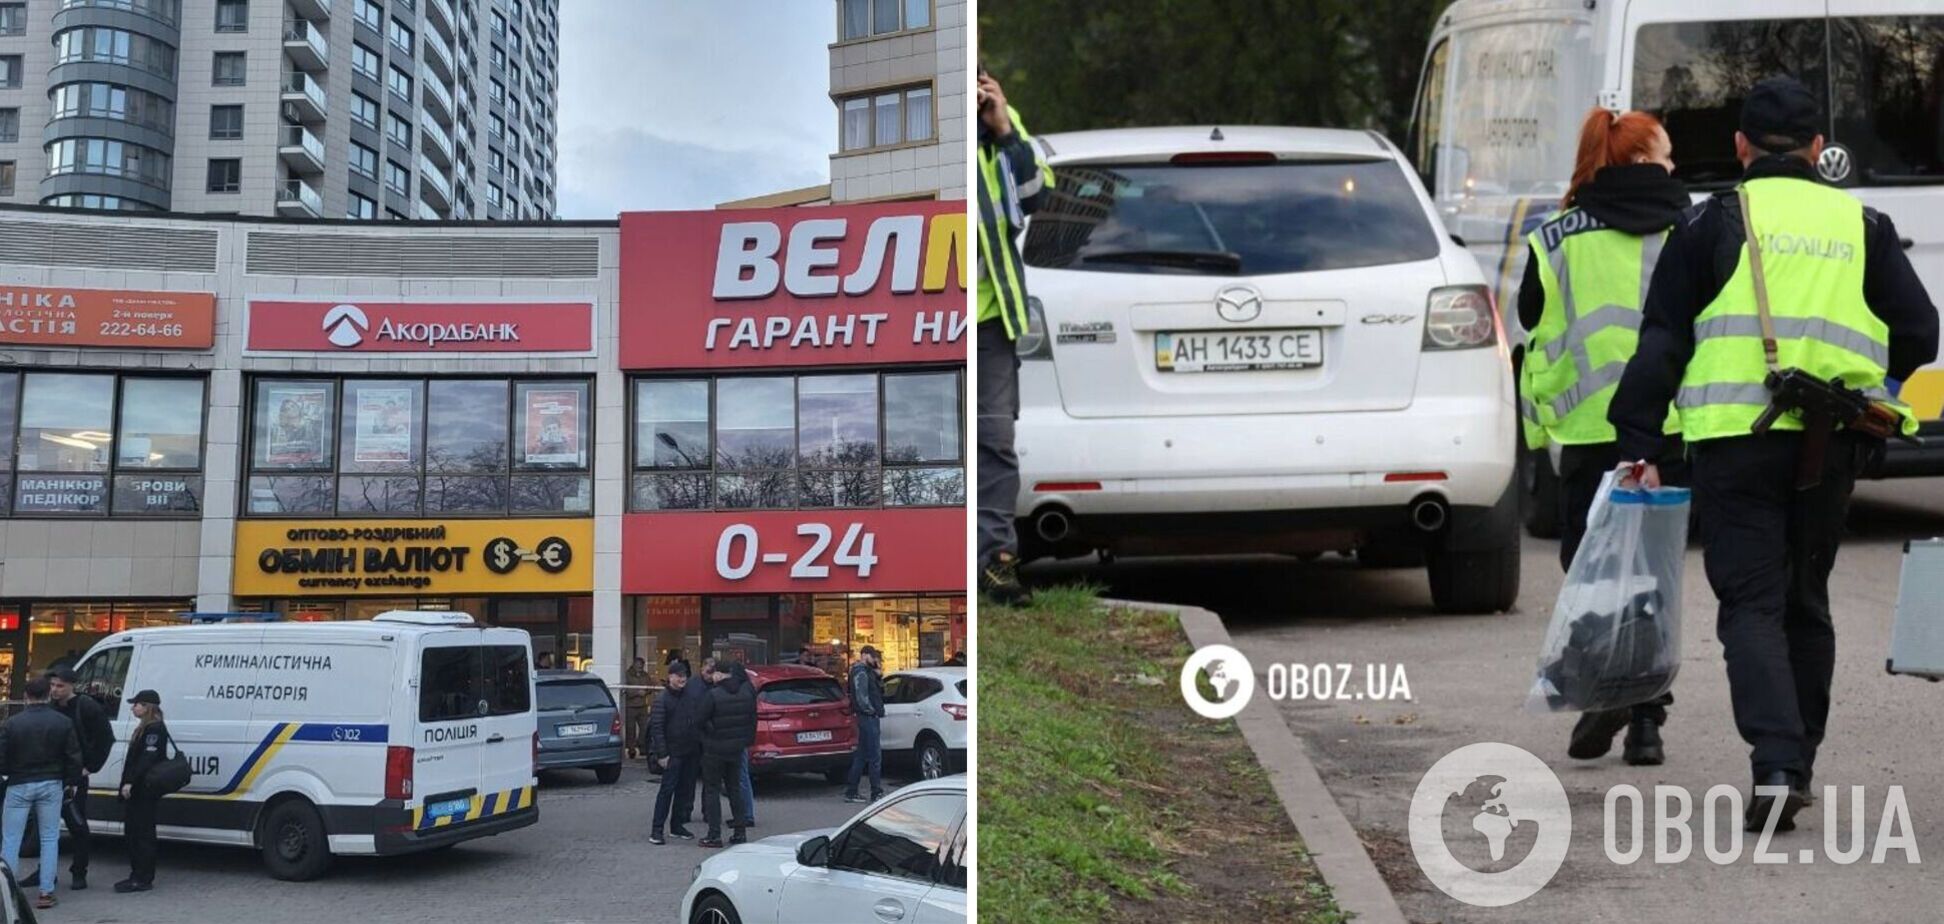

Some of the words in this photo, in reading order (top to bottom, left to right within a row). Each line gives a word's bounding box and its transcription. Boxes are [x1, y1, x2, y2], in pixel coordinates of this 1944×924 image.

[100, 321, 182, 337] 222-64-66
[705, 313, 887, 350] ГАРАНТ
[1216, 335, 1271, 360] 1433
[21, 479, 103, 490] МАНІКЮР
[22, 493, 100, 506] ПЕДІКЮР
[287, 525, 446, 541] ОПТОВО-РОЗДРІБНИЙ
[716, 523, 878, 580] 0-24
[258, 548, 355, 574] ОБМІН
[363, 546, 470, 573] ВАЛЮТ
[298, 577, 361, 589] currency
[364, 574, 431, 588] exchange
[195, 654, 332, 670] КРИМІНАЛІСТИЧНА
[206, 684, 308, 701] ЛАБОРАТОРІЯ
[344, 729, 361, 740] 102
[424, 724, 478, 743] ПОЛІЦІЯ
